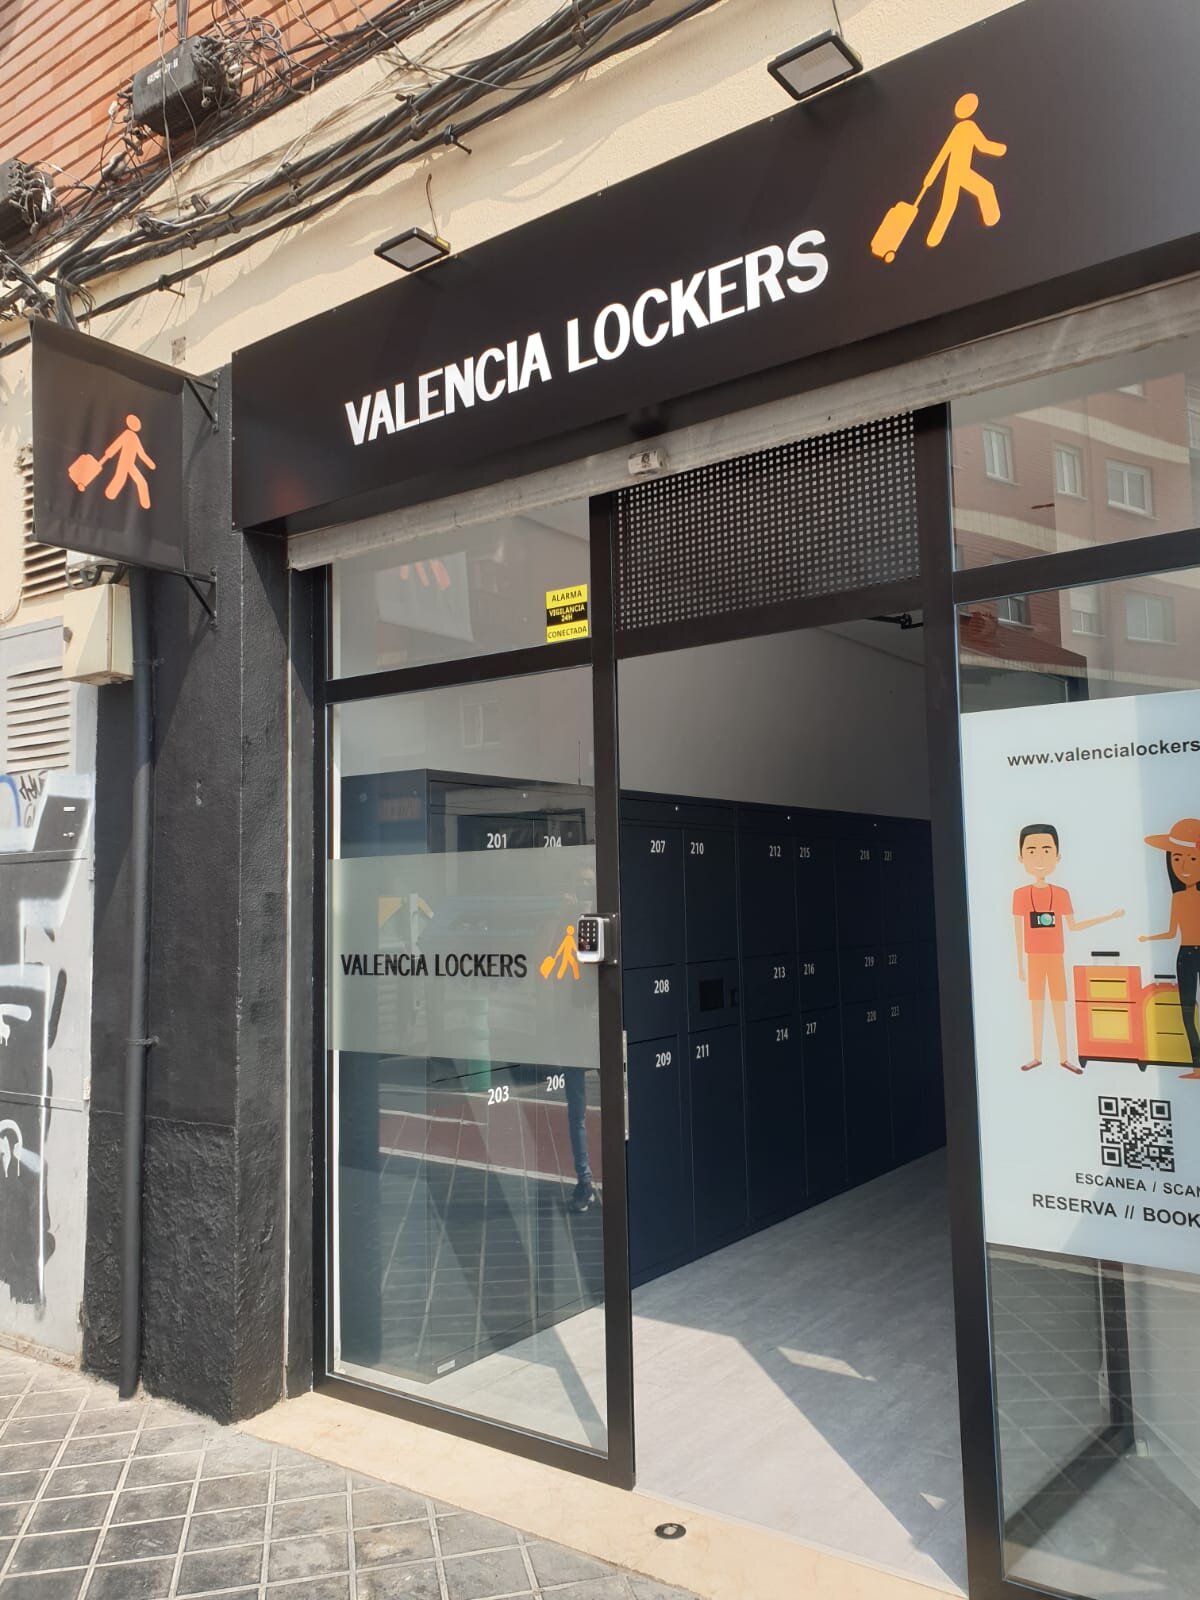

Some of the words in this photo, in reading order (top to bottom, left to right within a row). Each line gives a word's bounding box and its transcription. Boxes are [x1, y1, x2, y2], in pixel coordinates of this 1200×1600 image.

[344, 330, 552, 446] VALENCIA
[567, 228, 829, 373] LOCKERS
[552, 590, 582, 601] ALARMA
[549, 604, 585, 616] VIGILANCIA
[561, 613, 573, 622] 24H
[548, 626, 587, 638] CONECTADA
[1007, 739, 1200, 767] www.valencialockers
[486, 832, 507, 849] 201
[543, 835, 562, 848] 204
[650, 839, 666, 854] 207
[690, 841, 705, 855] 210
[769, 845, 781, 857] 212
[800, 847, 811, 858] 215
[340, 953, 429, 977] VALENCIA
[434, 953, 528, 978] LOCKERS
[773, 966, 786, 979] 213
[804, 963, 815, 976] 216
[654, 979, 670, 994] 208
[776, 1027, 789, 1042] 214
[806, 1022, 817, 1035] 217
[696, 1043, 710, 1060] 211
[655, 1051, 672, 1068] 209
[546, 1073, 566, 1092] 206
[487, 1085, 510, 1106] 203
[1075, 1172, 1147, 1192] ESCANEA
[1152, 1181, 1157, 1193] /
[1032, 1193, 1117, 1218] RESERVA
[1143, 1206, 1200, 1229] BOOK
